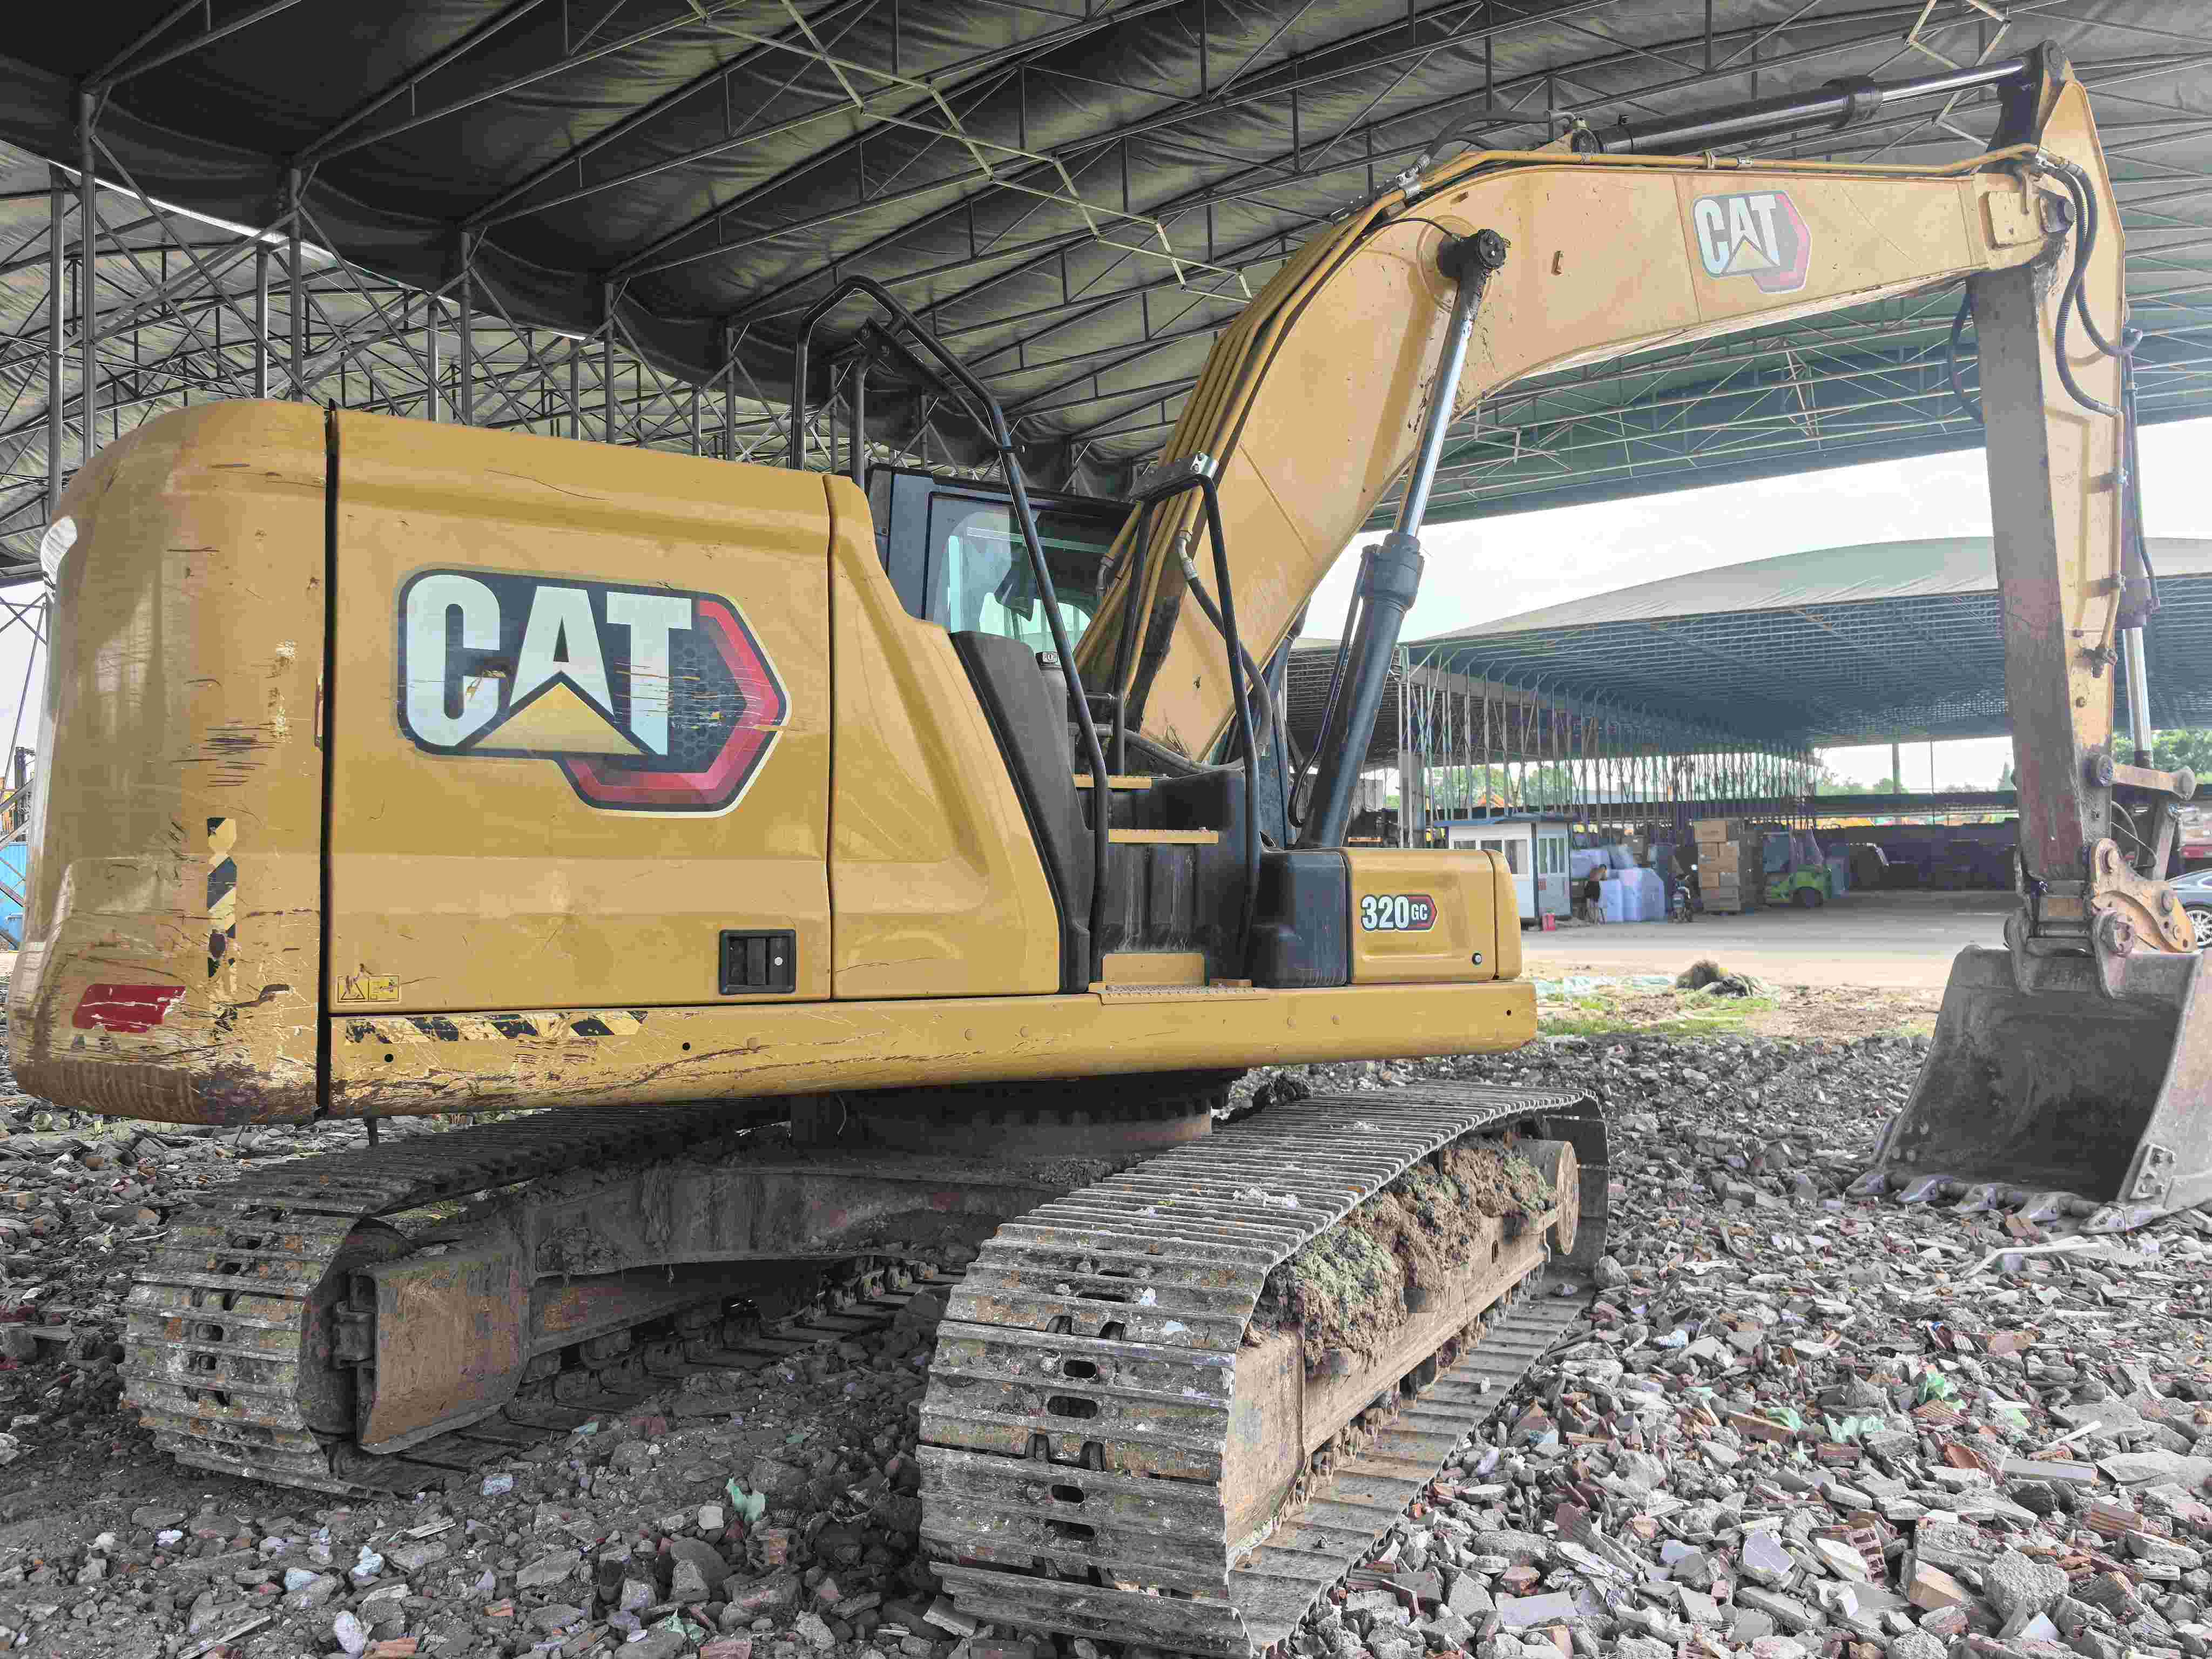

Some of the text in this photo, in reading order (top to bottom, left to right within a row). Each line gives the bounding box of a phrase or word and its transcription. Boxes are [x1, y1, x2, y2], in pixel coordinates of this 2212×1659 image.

[1695, 194, 1780, 273] CAT
[407, 575, 692, 756] CAT
[1361, 896, 1427, 929] 320 GC
